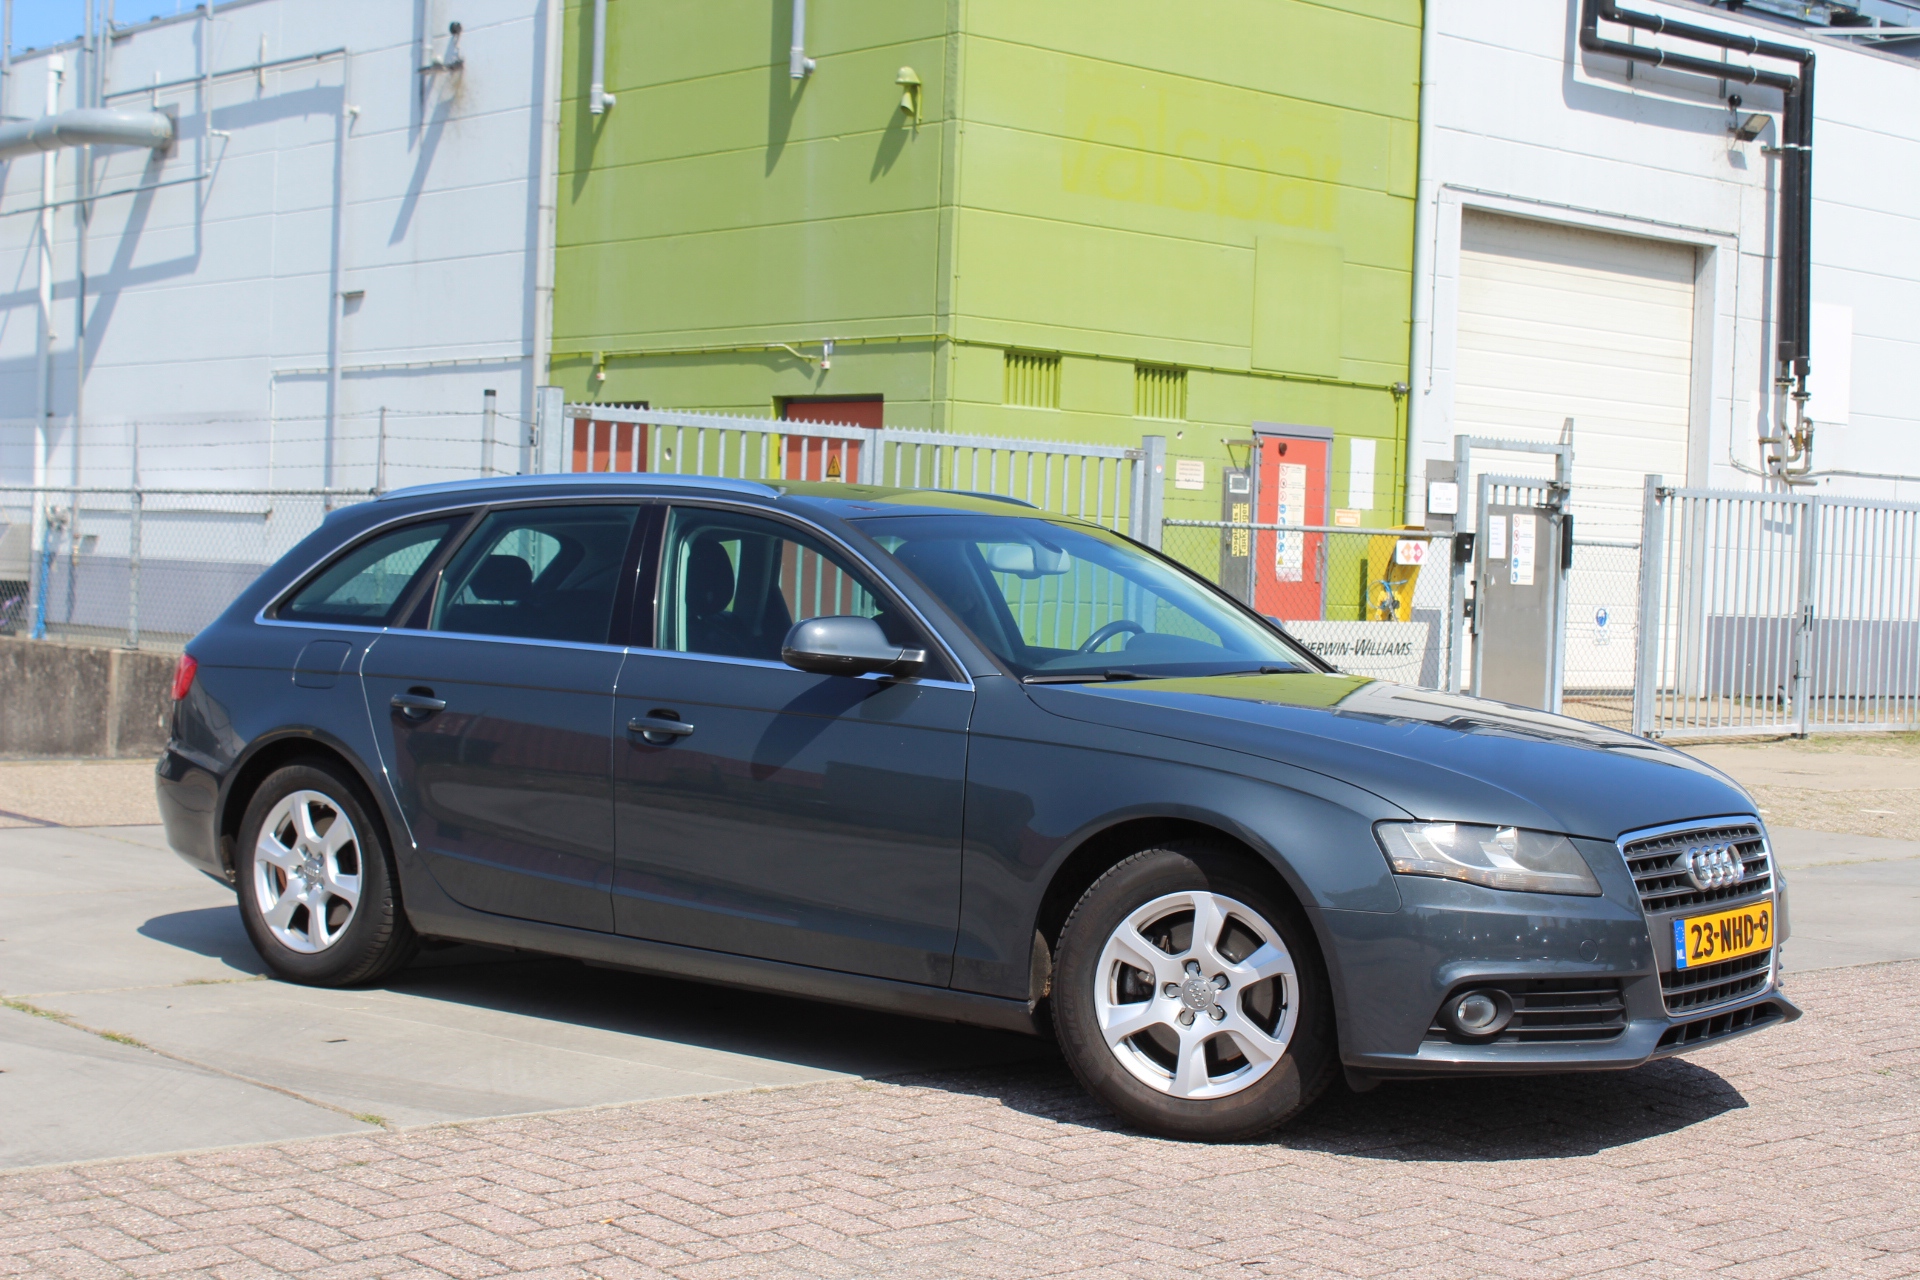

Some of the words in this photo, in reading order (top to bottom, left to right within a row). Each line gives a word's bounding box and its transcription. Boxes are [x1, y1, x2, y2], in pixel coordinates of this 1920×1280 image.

[1231, 512, 1240, 557] Losplats
[1298, 638, 1412, 656] ERWIN-WILLIAMS
[1691, 910, 1769, 960] 23-NHD-9
[1676, 949, 1685, 960] NL
